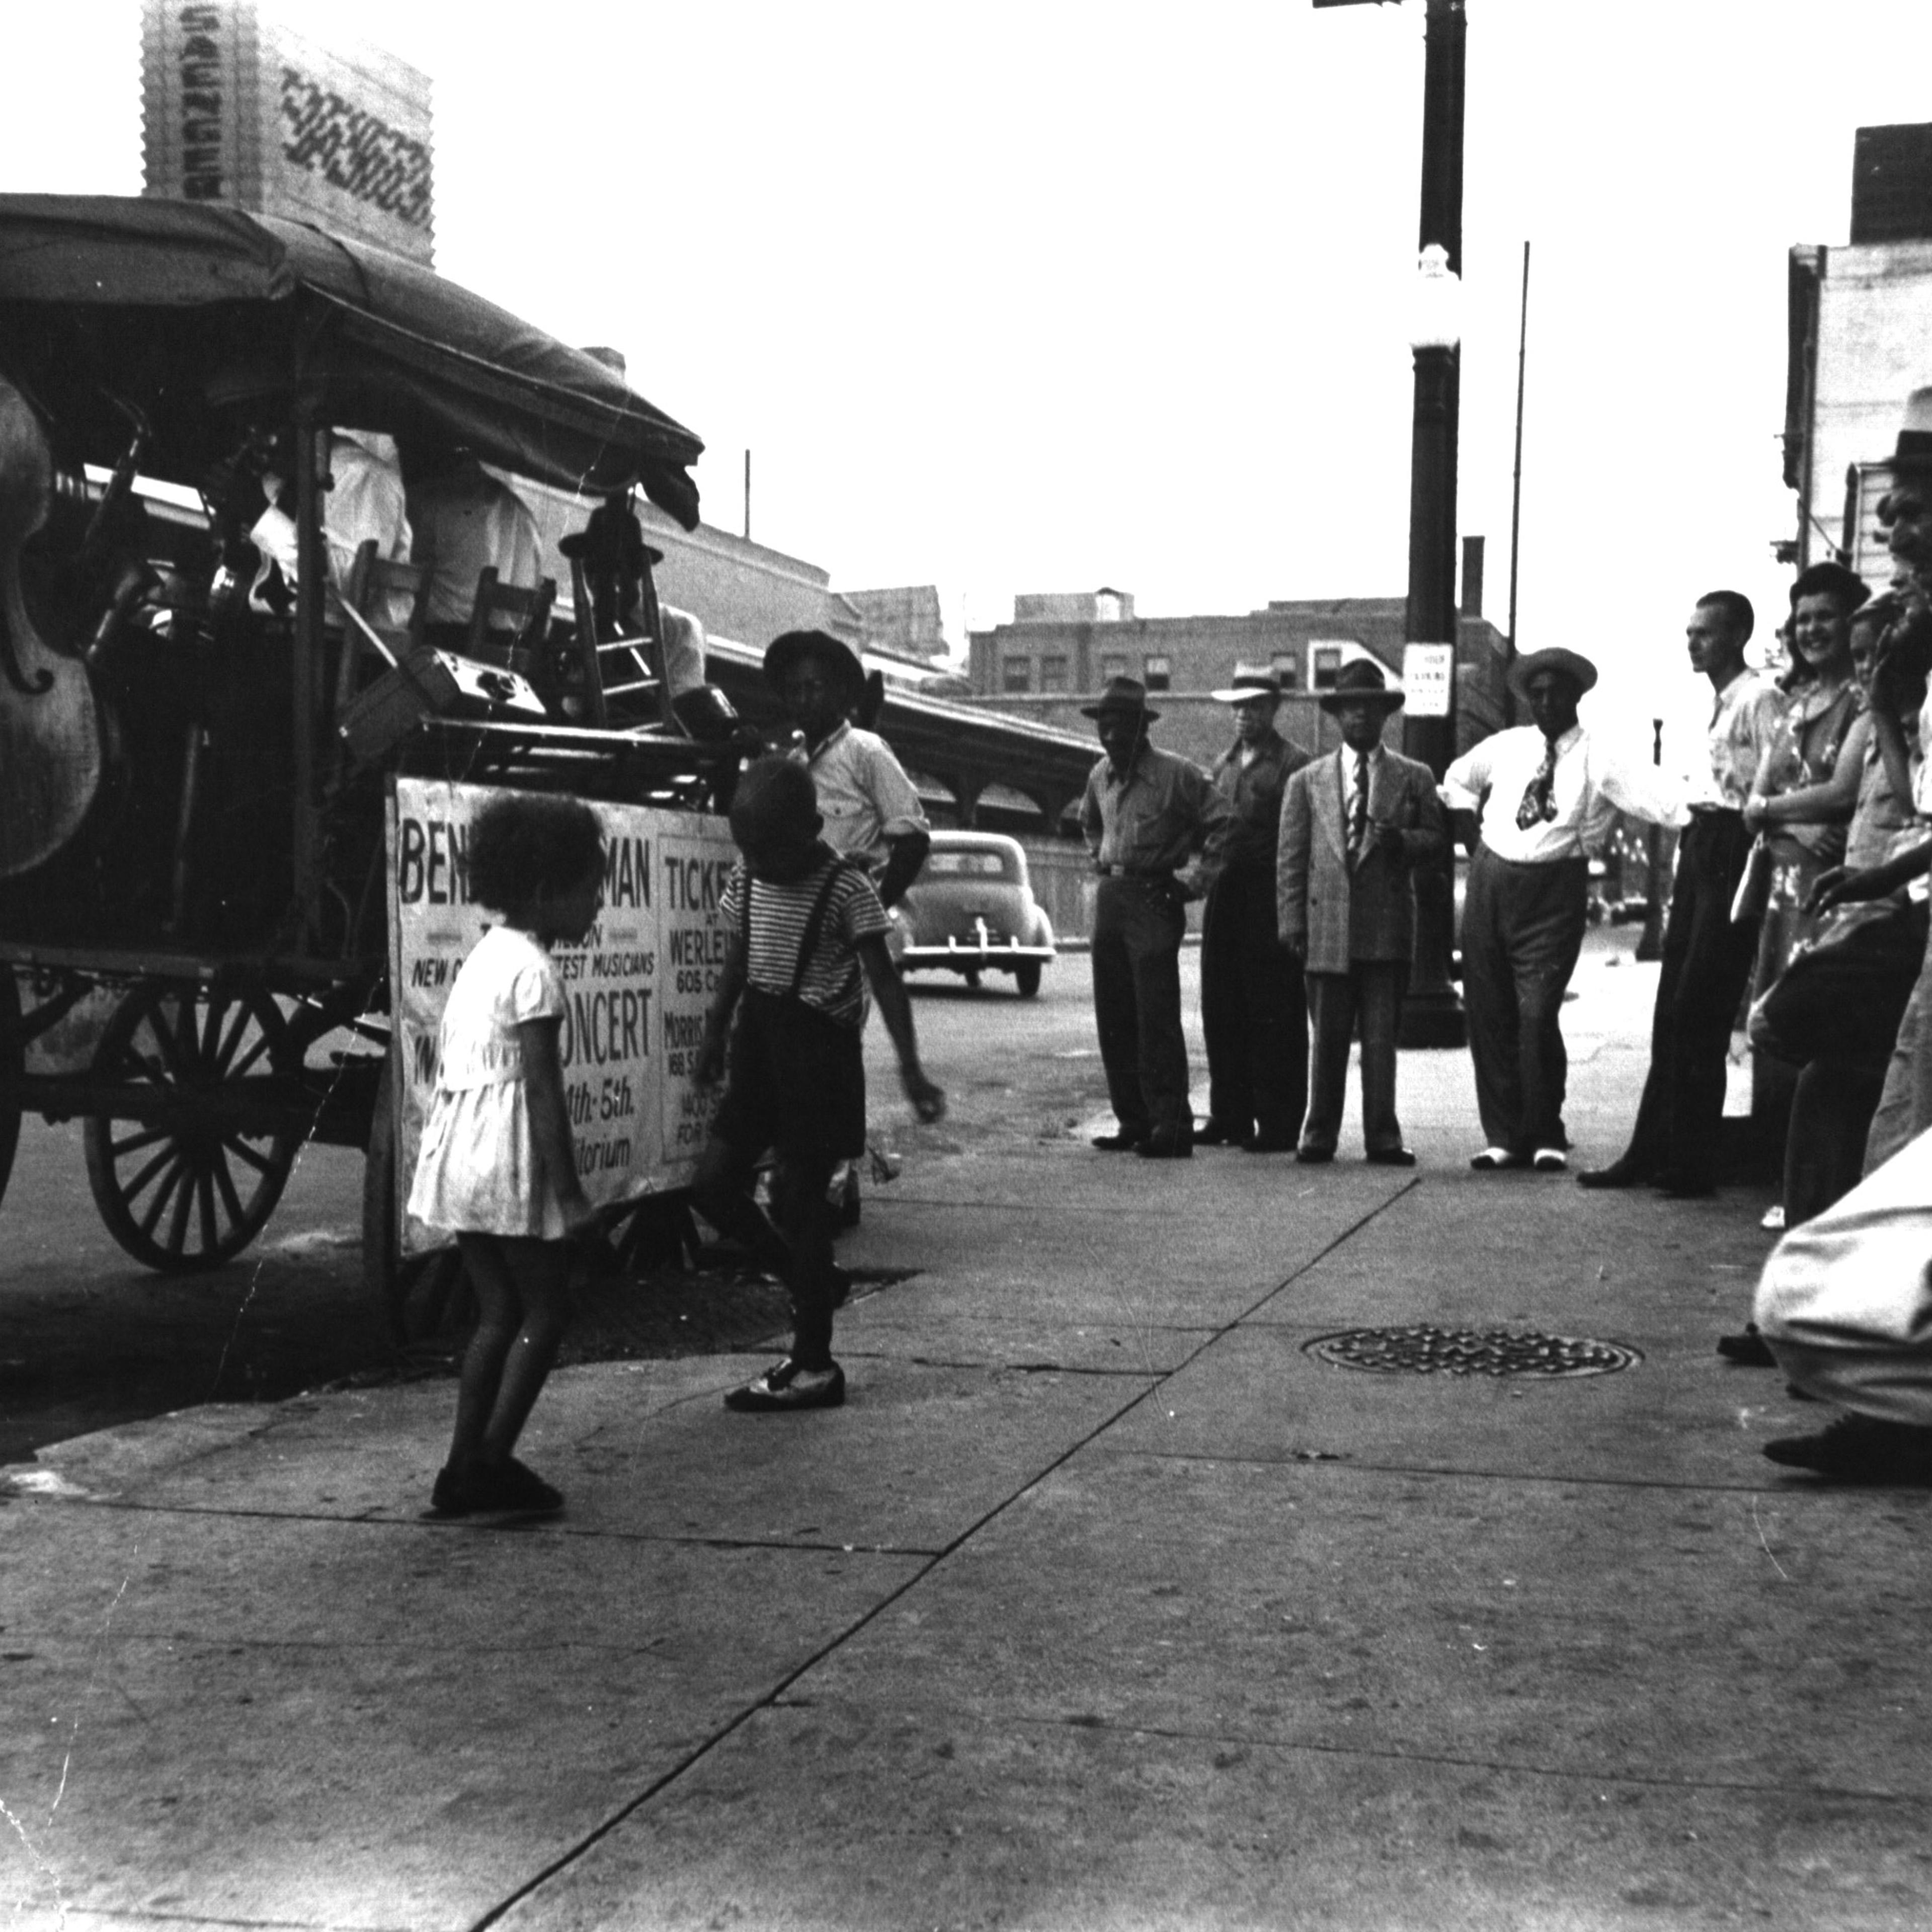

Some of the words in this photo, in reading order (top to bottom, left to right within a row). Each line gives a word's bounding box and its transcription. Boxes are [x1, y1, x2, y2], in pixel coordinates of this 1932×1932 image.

[399, 817, 471, 905] BEN
[596, 836, 650, 908] MAN
[665, 856, 737, 911] TICKE
[706, 913, 719, 926] AT
[412, 958, 449, 988] NEW
[553, 953, 588, 980] TEST
[592, 951, 655, 979] MUSICIANS
[677, 970, 703, 994] 605
[560, 988, 653, 1070] ONCERT
